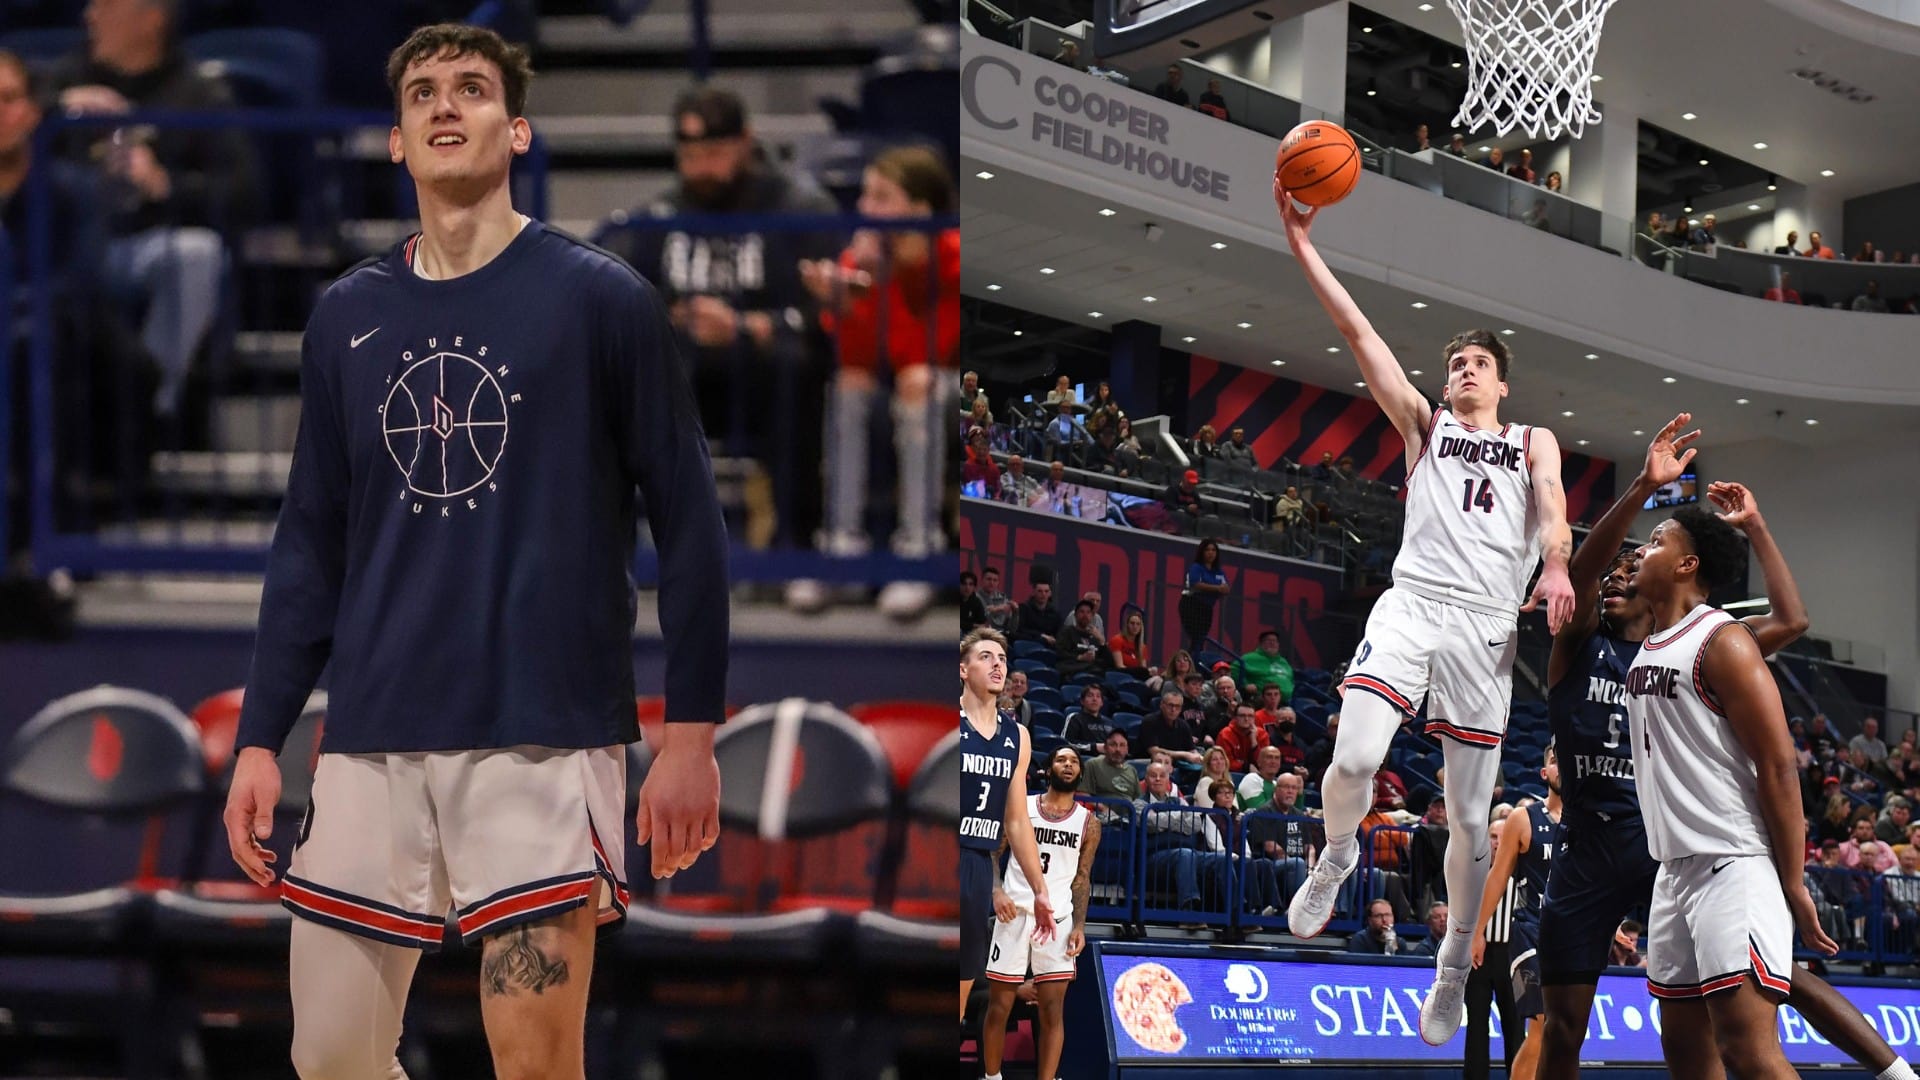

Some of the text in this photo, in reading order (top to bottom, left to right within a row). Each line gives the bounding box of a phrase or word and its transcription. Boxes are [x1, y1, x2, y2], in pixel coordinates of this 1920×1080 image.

[1034, 75, 1169, 145] COOPER
[1032, 112, 1230, 202] FIELDHOUSE
[378, 336, 522, 413] DQUESNE
[399, 480, 497, 517] DUKES
[1462, 479, 1494, 513] 14
[1586, 676, 1627, 706] NOR
[1626, 665, 1680, 699] QUESNE
[1603, 713, 1622, 748] 5
[961, 752, 1012, 779] NORTH
[1575, 754, 1636, 779] FLORID
[976, 781, 991, 811] 3
[960, 816, 1001, 840] ORIDA
[1034, 827, 1079, 849] QUESNE
[1040, 852, 1051, 874] 3
